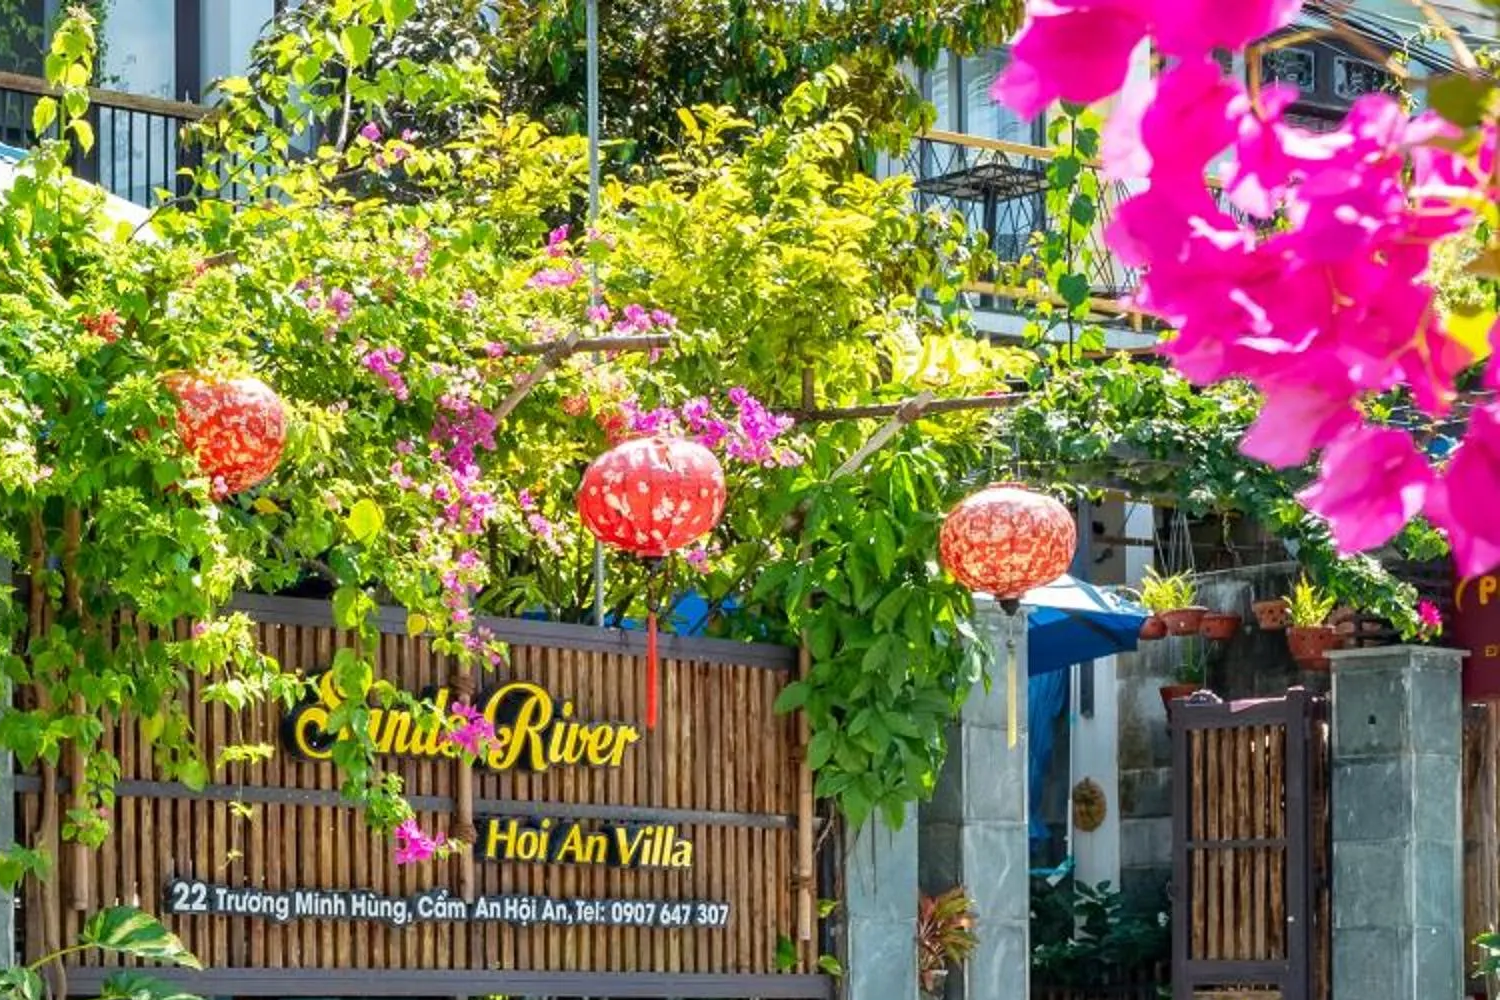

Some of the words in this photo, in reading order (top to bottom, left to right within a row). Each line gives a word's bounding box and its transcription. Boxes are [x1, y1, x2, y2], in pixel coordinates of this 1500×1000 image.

[483, 681, 641, 772] River
[486, 818, 551, 861] Hoi
[556, 823, 608, 863] An
[615, 824, 693, 867] Villa
[172, 881, 208, 911] 22
[215, 888, 289, 920] Trương
[295, 891, 346, 915] Minh
[351, 892, 413, 923] Hùng,
[417, 888, 467, 919] Cẩm
[504, 896, 537, 927] Hội
[541, 899, 573, 925] An,
[575, 900, 605, 921] Tel:
[611, 903, 656, 925] 0907
[659, 903, 691, 925] 647
[697, 904, 729, 925] 307
